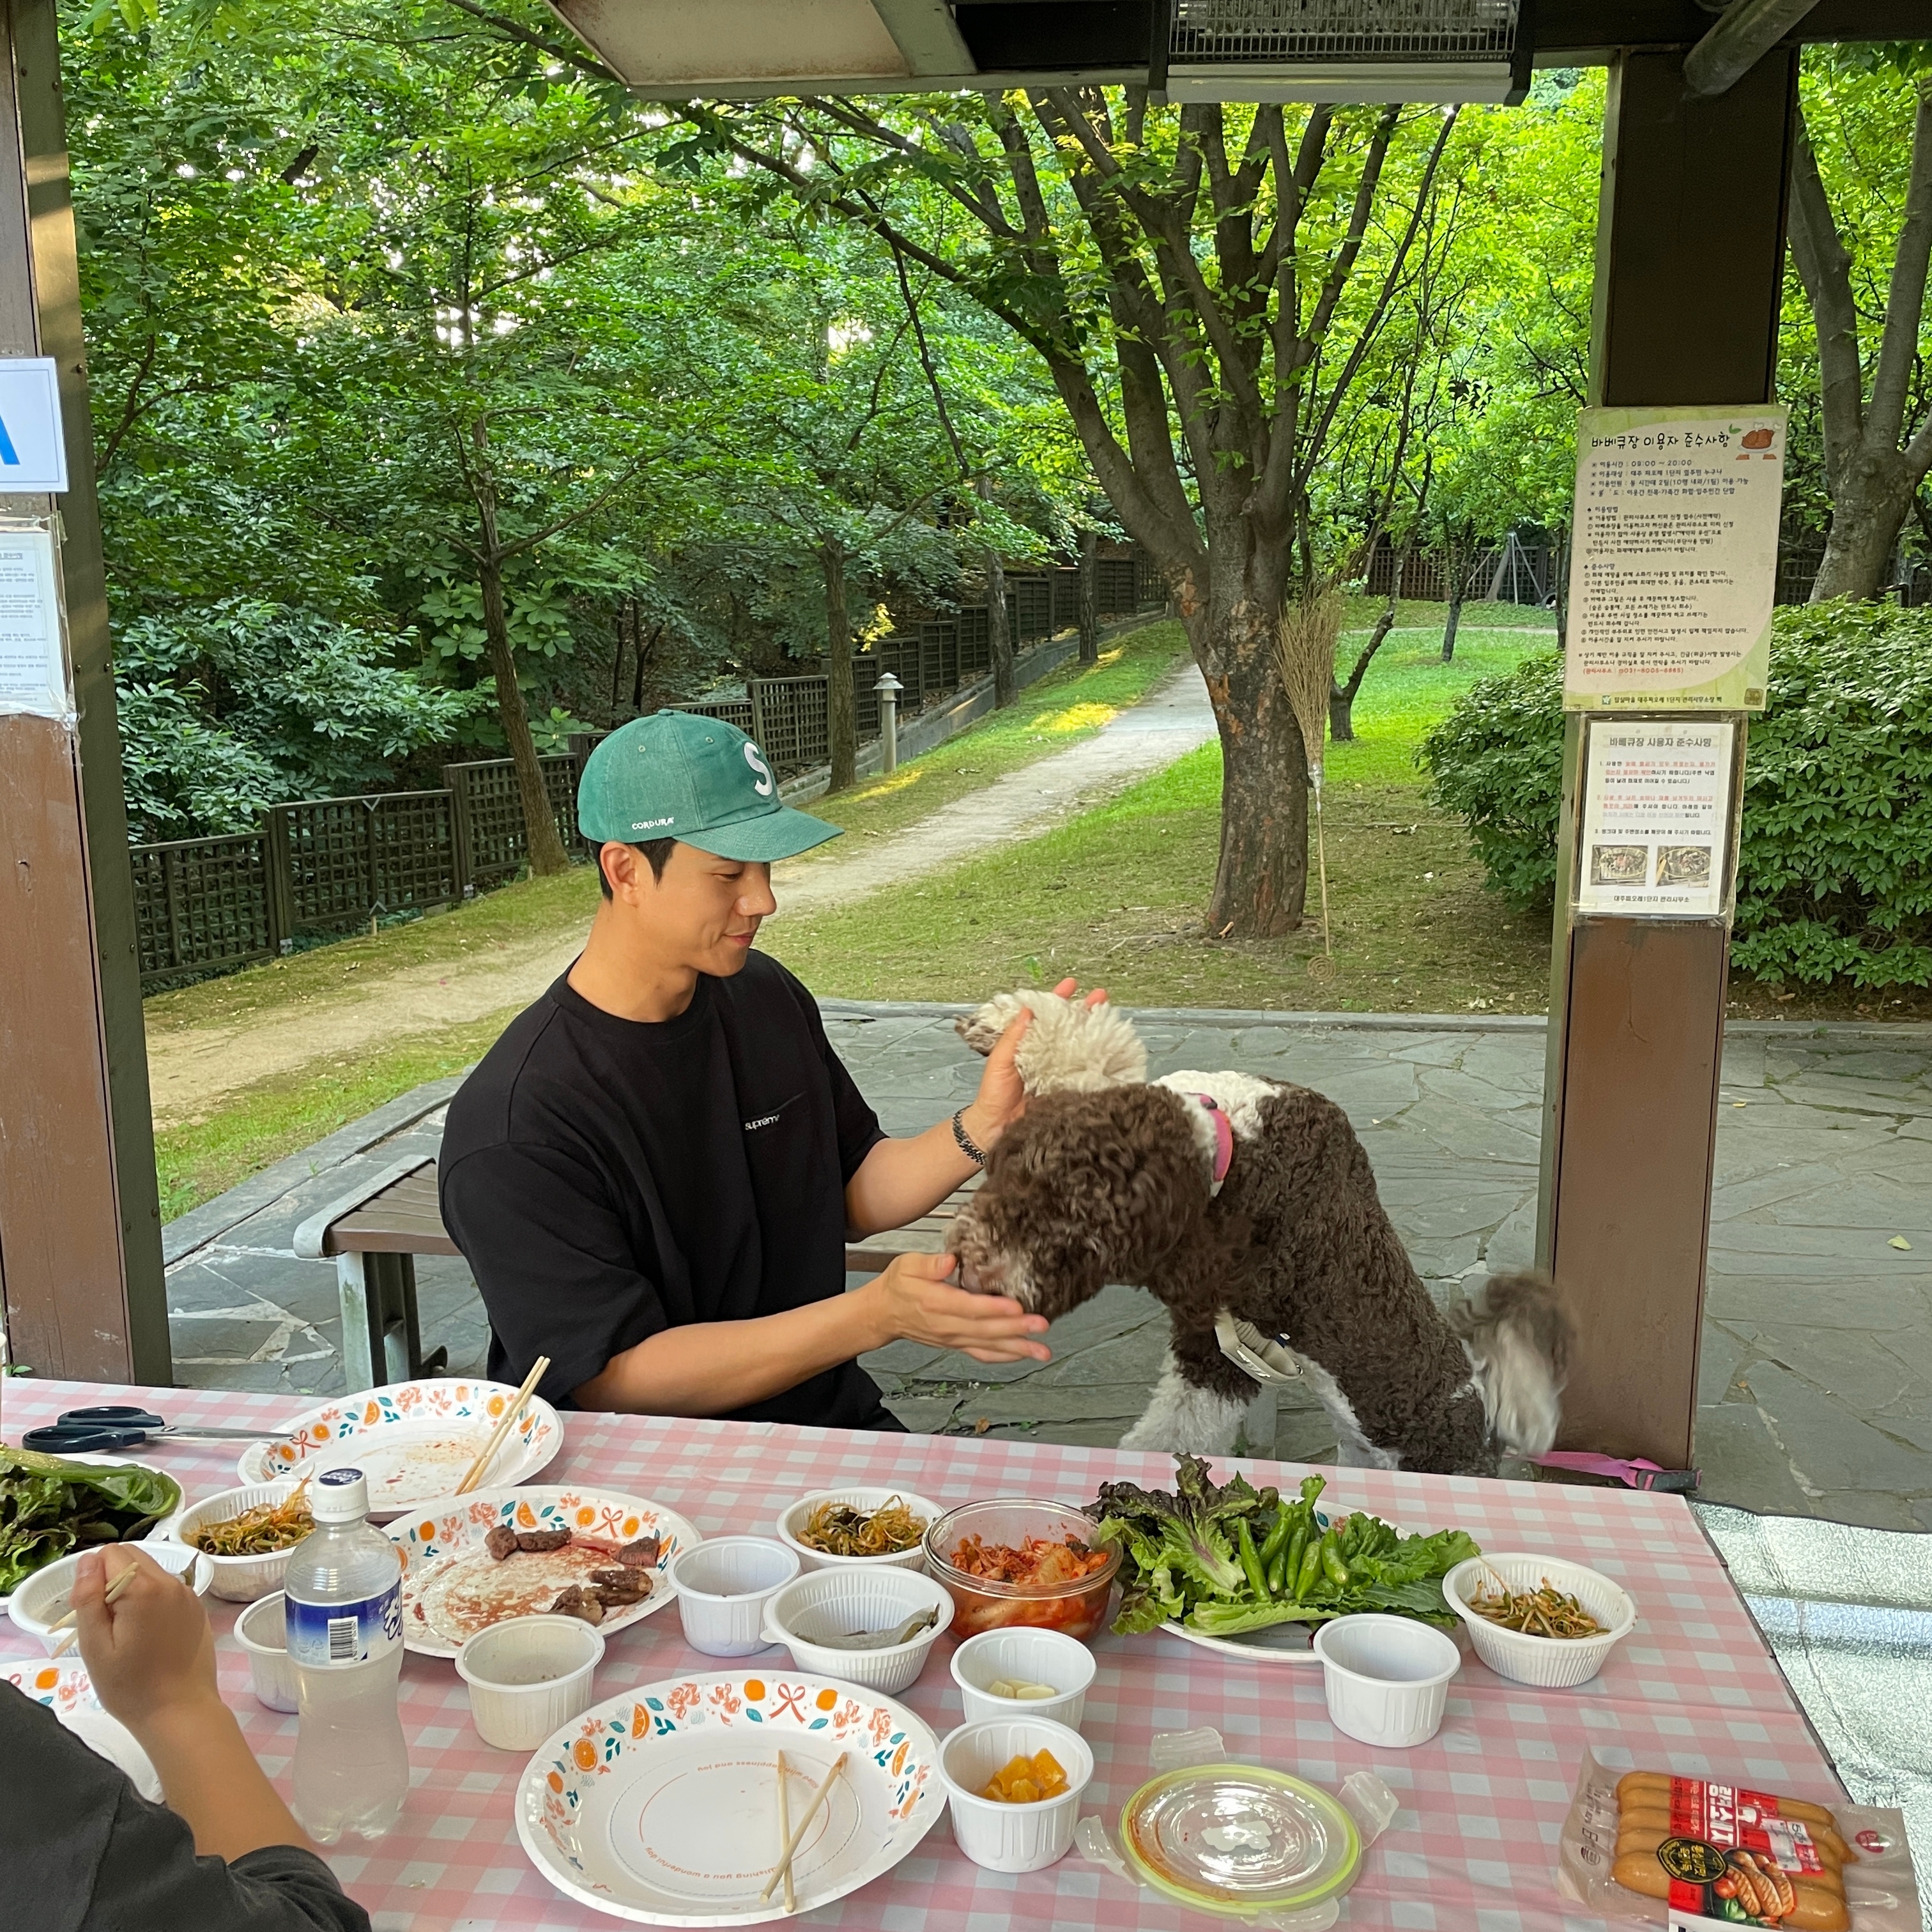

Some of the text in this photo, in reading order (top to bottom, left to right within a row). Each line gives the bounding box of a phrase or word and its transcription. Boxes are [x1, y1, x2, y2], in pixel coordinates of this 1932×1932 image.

[1591, 431, 1730, 450] 바베큐장 이용자 준수사항
[1610, 738, 1711, 747] 바베큐장 사용자 준수사항
[744, 742, 772, 796] S
[631, 816, 674, 830] CORDURA
